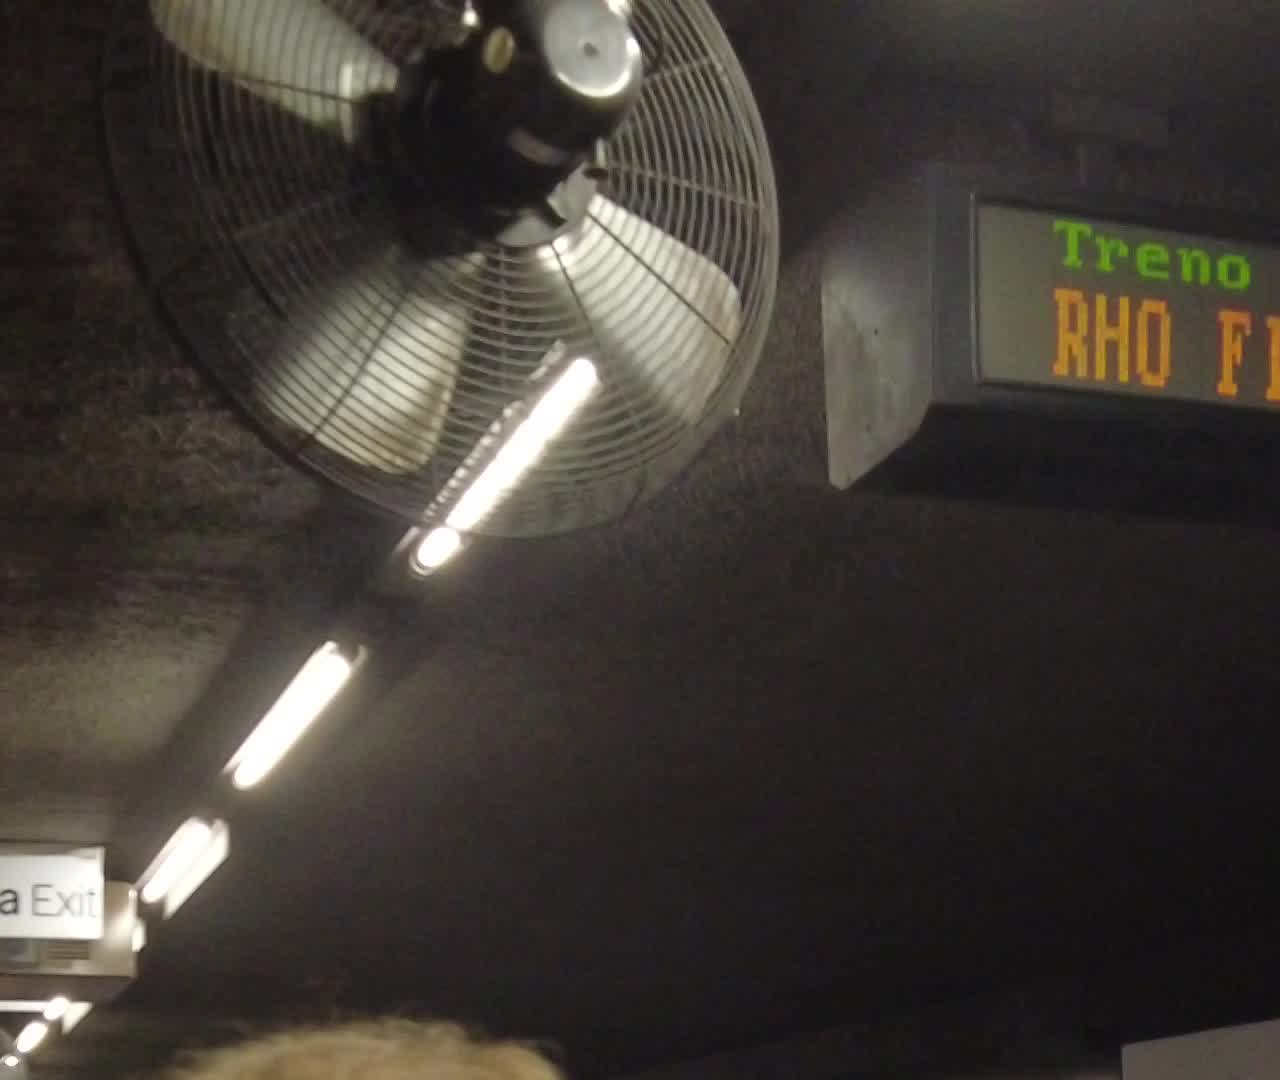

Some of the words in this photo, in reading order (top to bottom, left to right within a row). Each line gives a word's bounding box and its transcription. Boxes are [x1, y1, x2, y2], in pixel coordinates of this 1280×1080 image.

[1054, 219, 1252, 291] Treno
[1053, 287, 1171, 388] RHO
[31, 883, 97, 920] Exit
